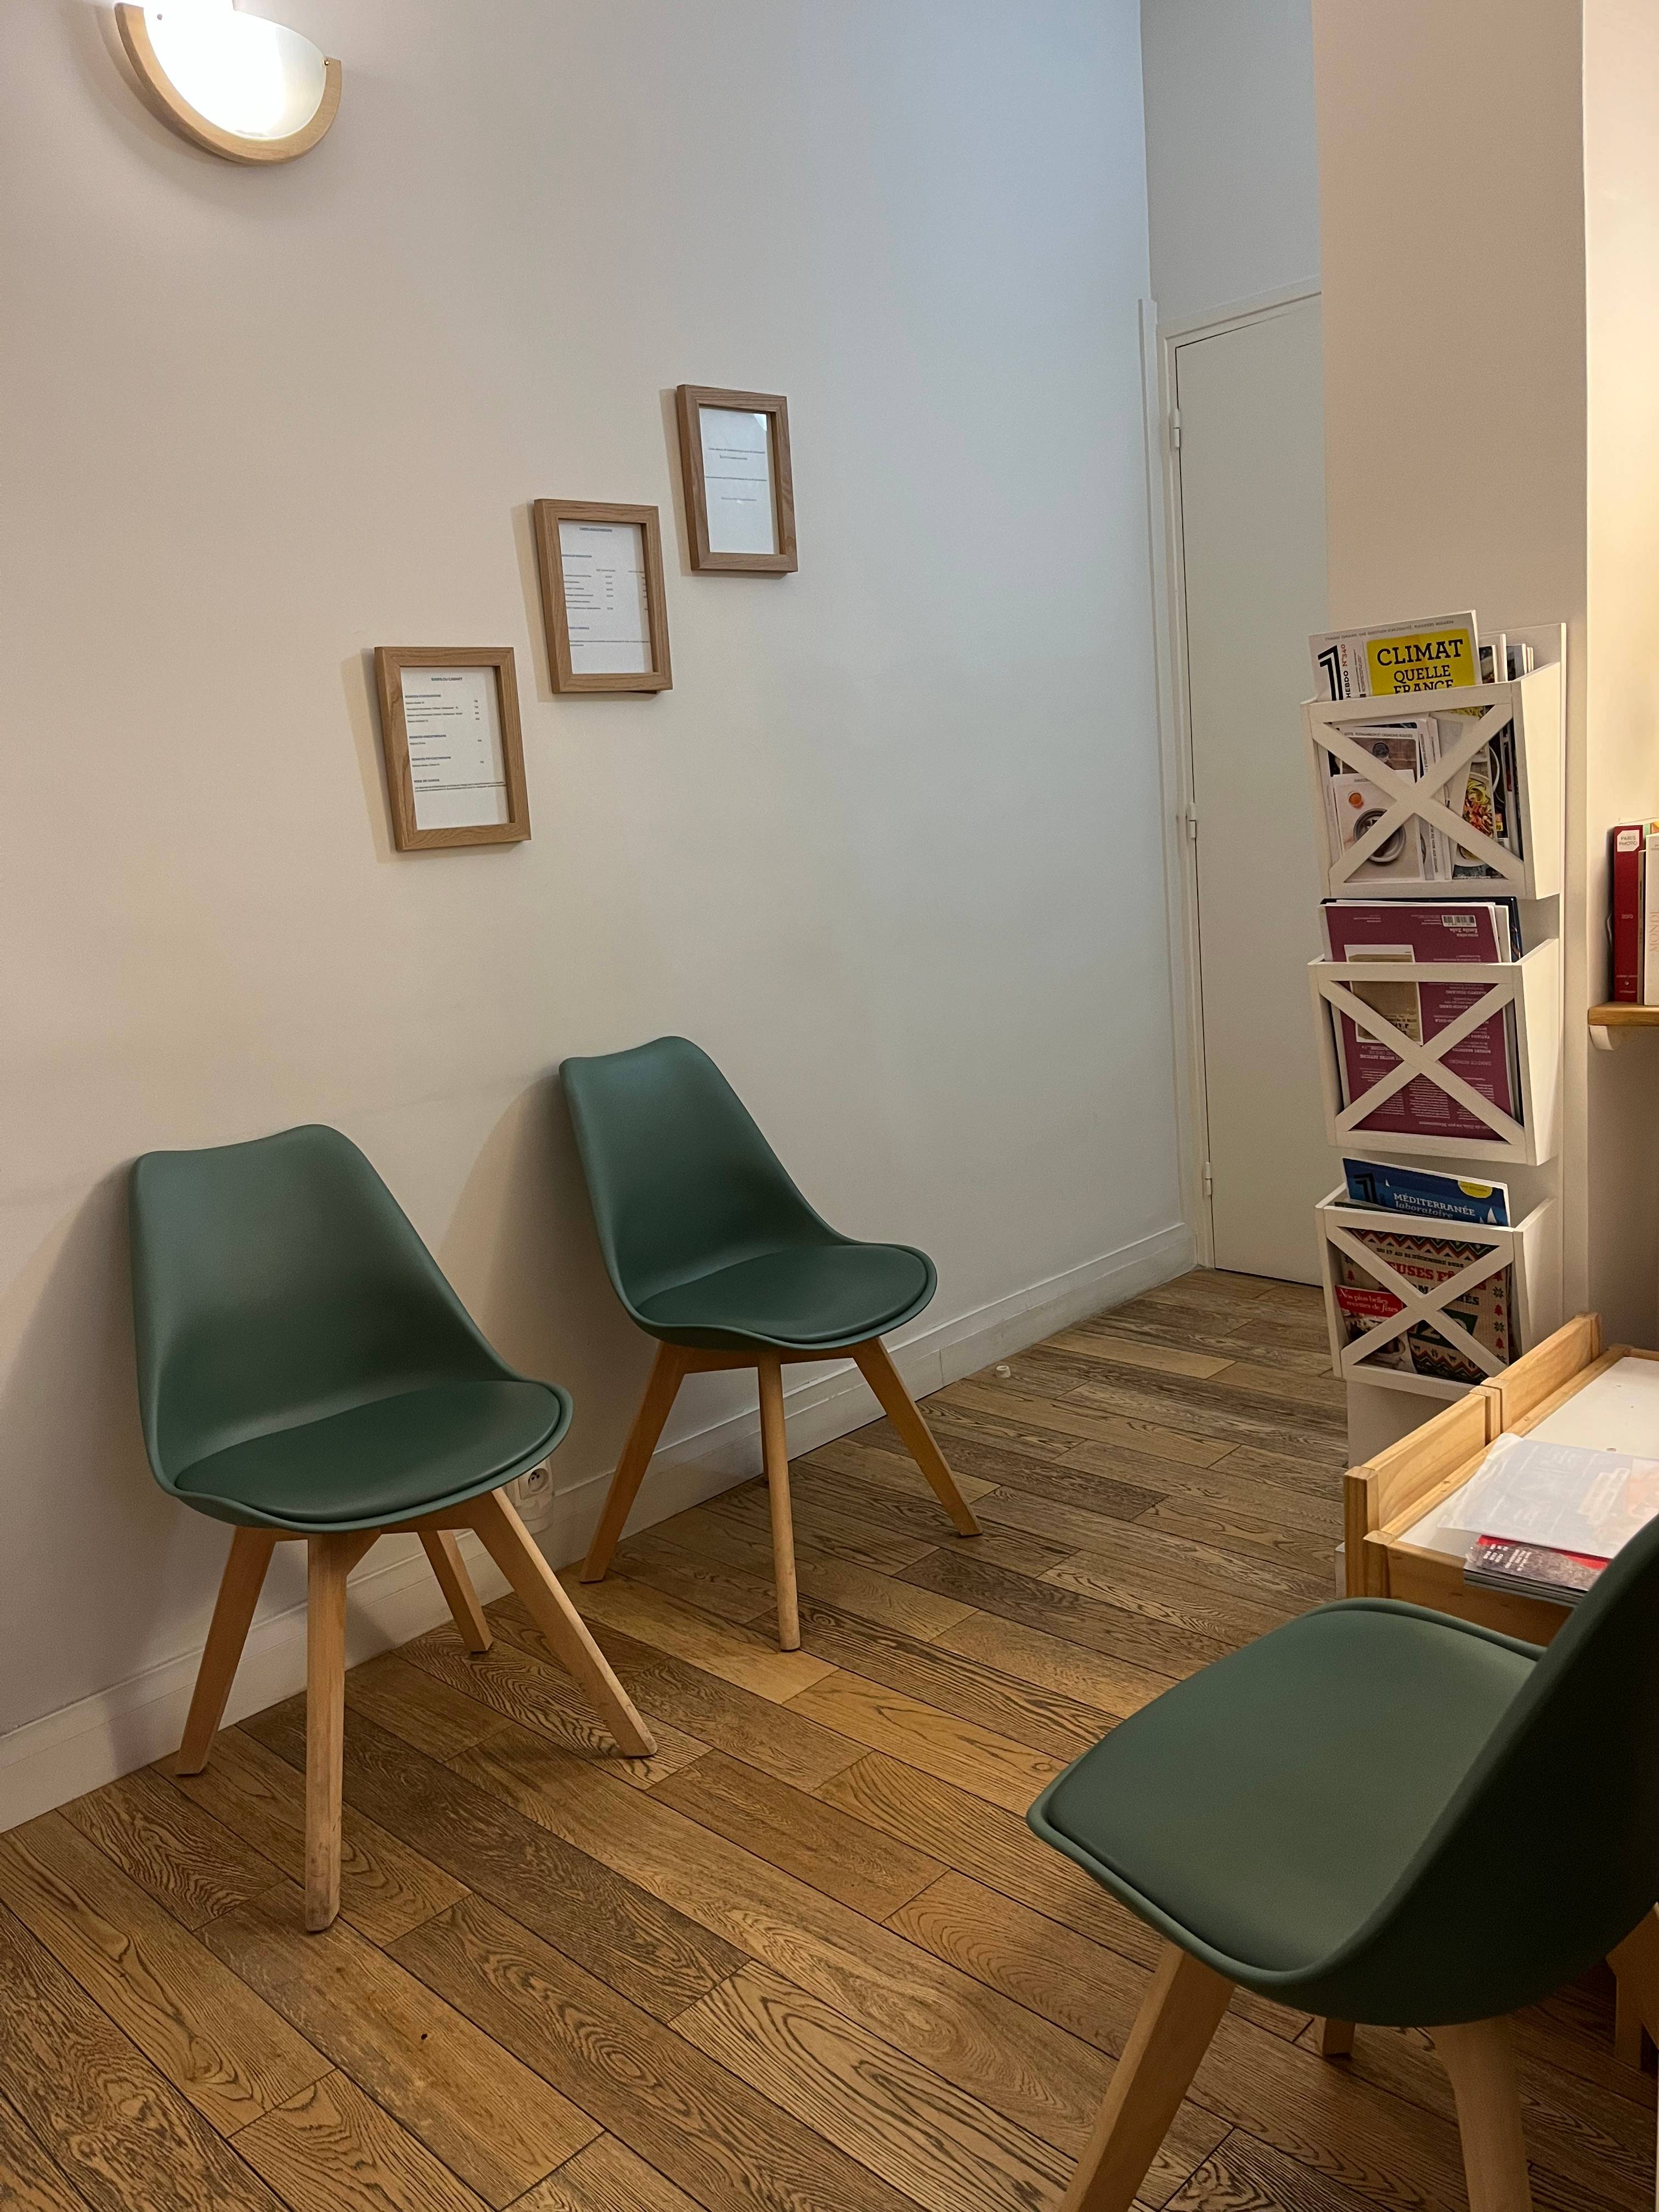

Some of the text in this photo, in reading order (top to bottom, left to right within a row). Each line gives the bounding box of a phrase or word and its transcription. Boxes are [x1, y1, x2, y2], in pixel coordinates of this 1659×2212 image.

[1377, 639, 1464, 666] CLIMAT
[1343, 670, 1351, 698] HEBDO
[1393, 664, 1452, 684] QUELLE
[1393, 1192, 1476, 1216] MÉDITERRANÉE
[1395, 1200, 1453, 1219] laboratoire
[1339, 1288, 1389, 1304] Nos plus belles
